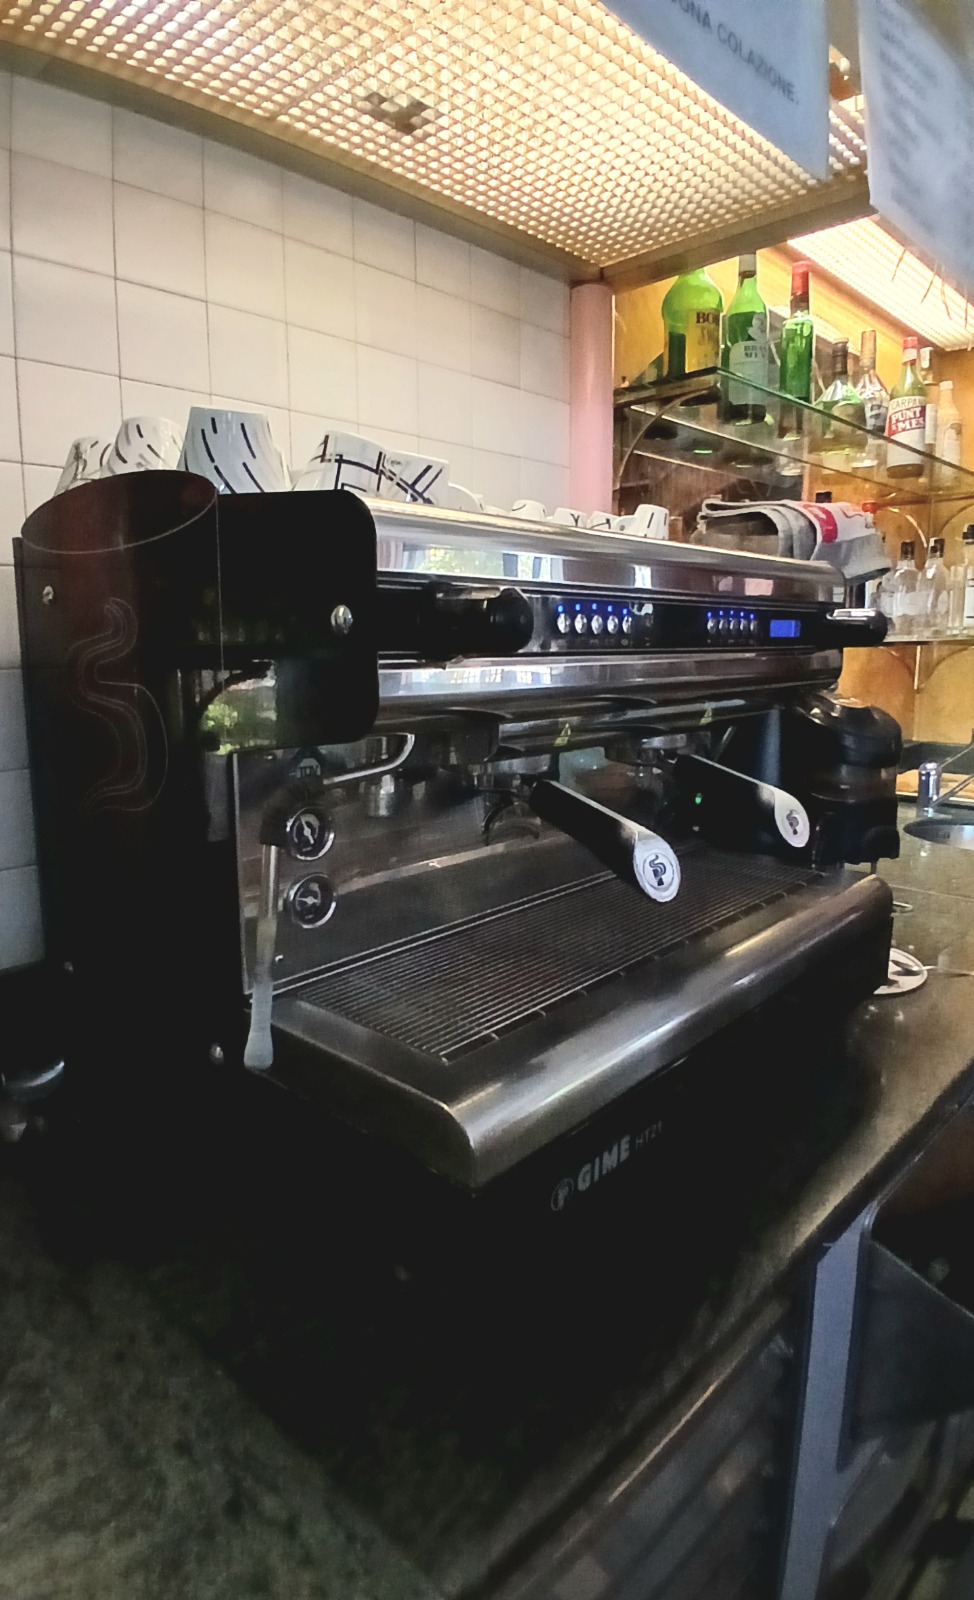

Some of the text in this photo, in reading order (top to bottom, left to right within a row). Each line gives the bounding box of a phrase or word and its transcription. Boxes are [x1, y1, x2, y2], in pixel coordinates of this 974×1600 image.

[891, 407, 921, 424] PUNT
[898, 417, 925, 432] MES
[577, 1134, 630, 1192] GIME
